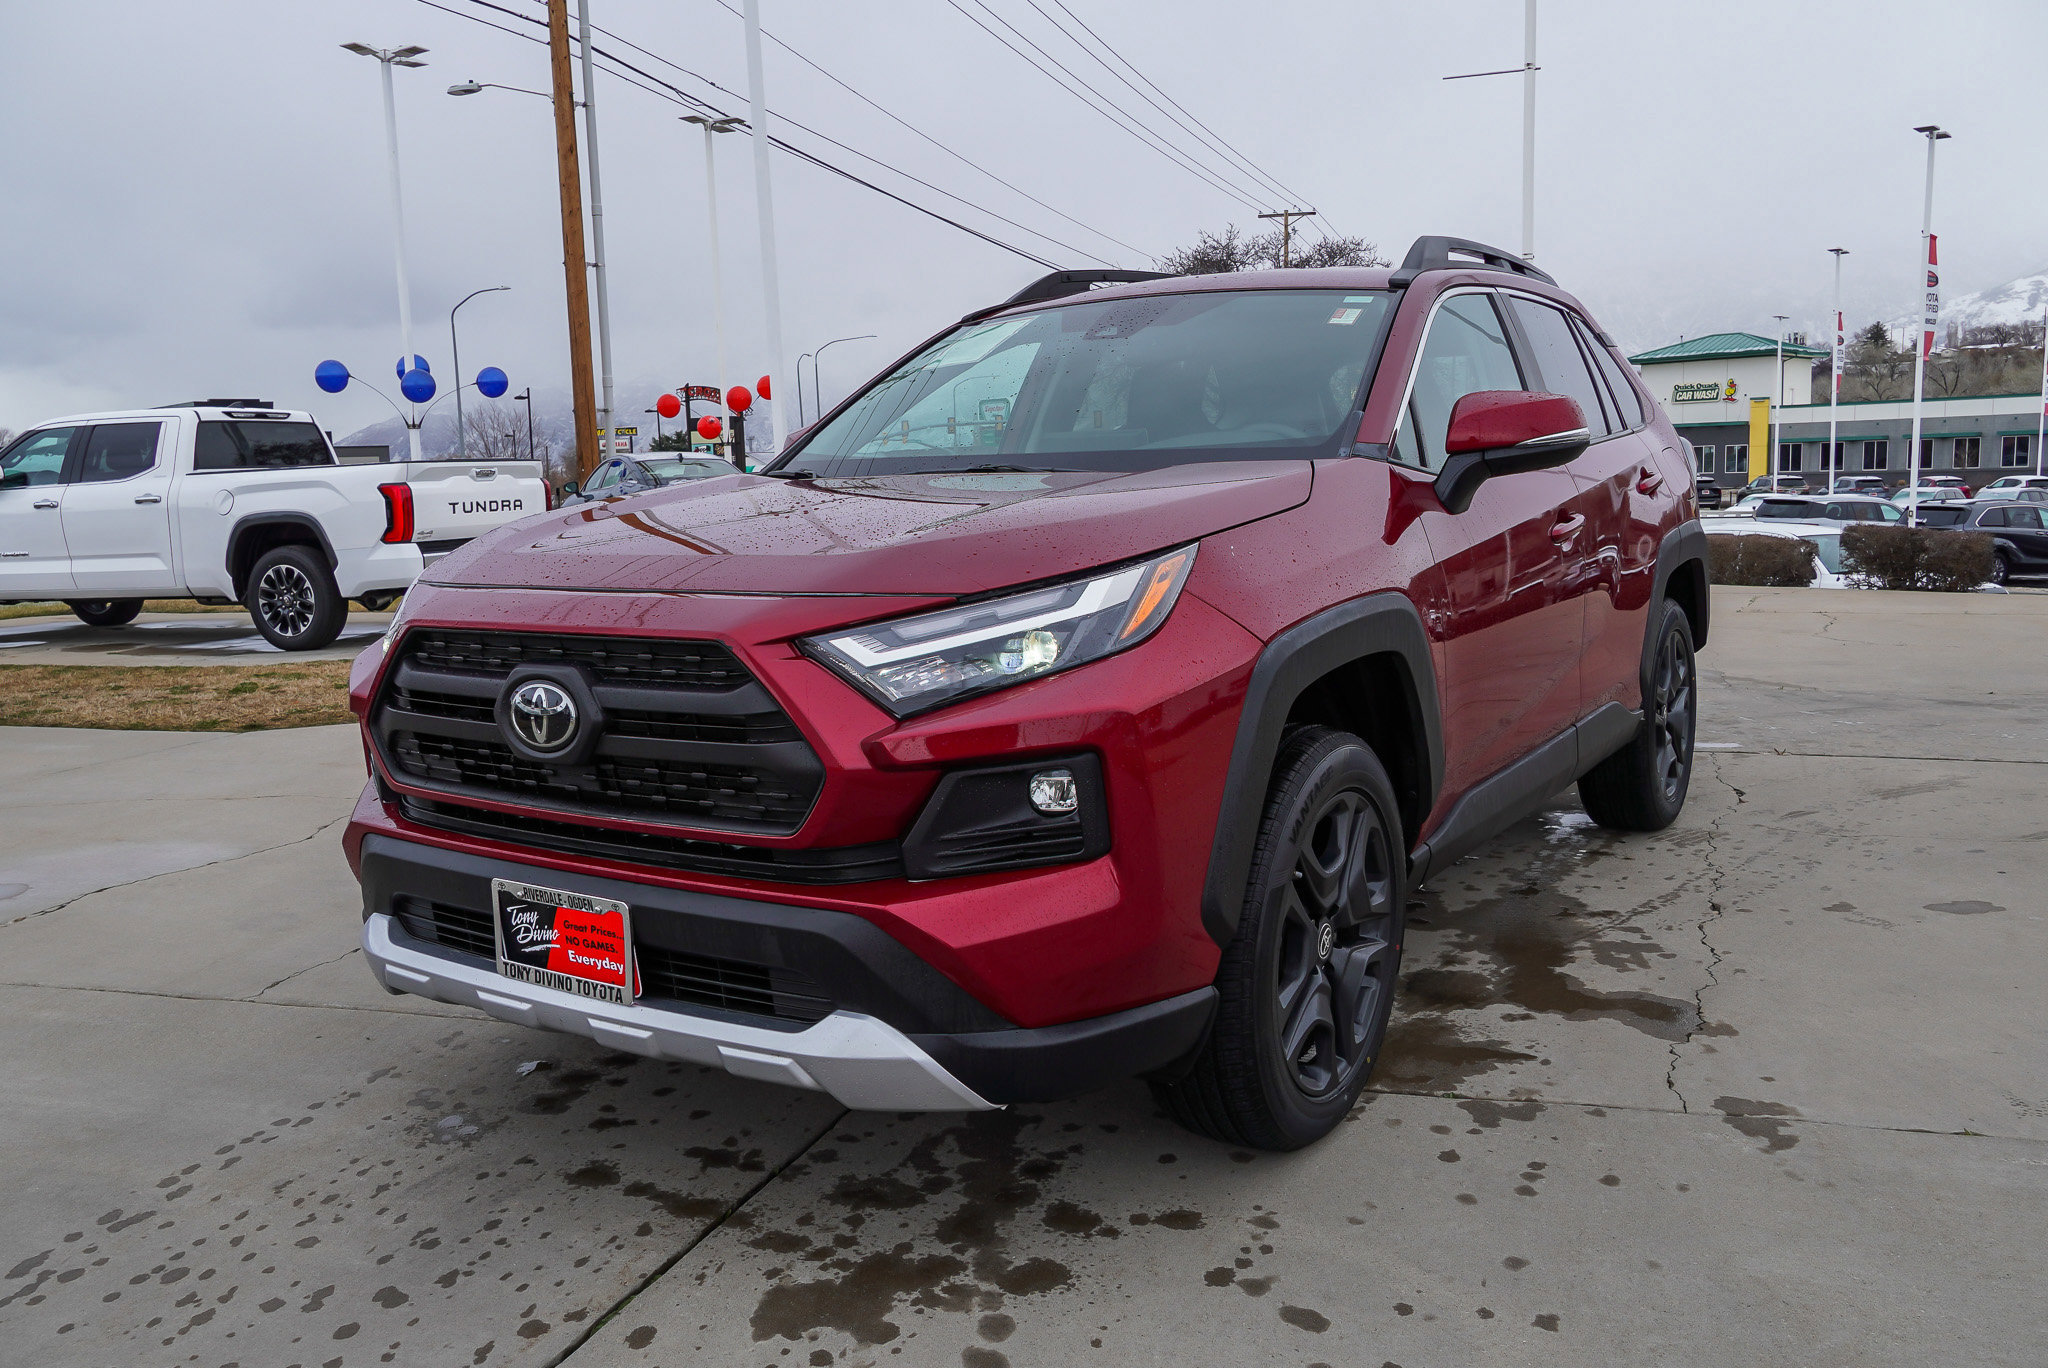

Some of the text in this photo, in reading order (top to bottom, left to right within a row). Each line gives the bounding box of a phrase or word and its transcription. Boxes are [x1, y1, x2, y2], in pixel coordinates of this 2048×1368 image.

[1676, 389, 1718, 400] CAR WASH
[448, 499, 523, 515] TUNDRA
[1289, 764, 1334, 845] VANTAGE
[522, 887, 564, 906] RIVERDALE
[567, 895, 594, 912] OGDEN
[507, 904, 540, 929] Tony
[563, 920, 588, 933] Great
[511, 924, 560, 944] Divino
[565, 935, 619, 954] NO GAMES.
[567, 949, 624, 975] Everyday
[503, 961, 624, 1004] TONY DIVINO TOYOTA
